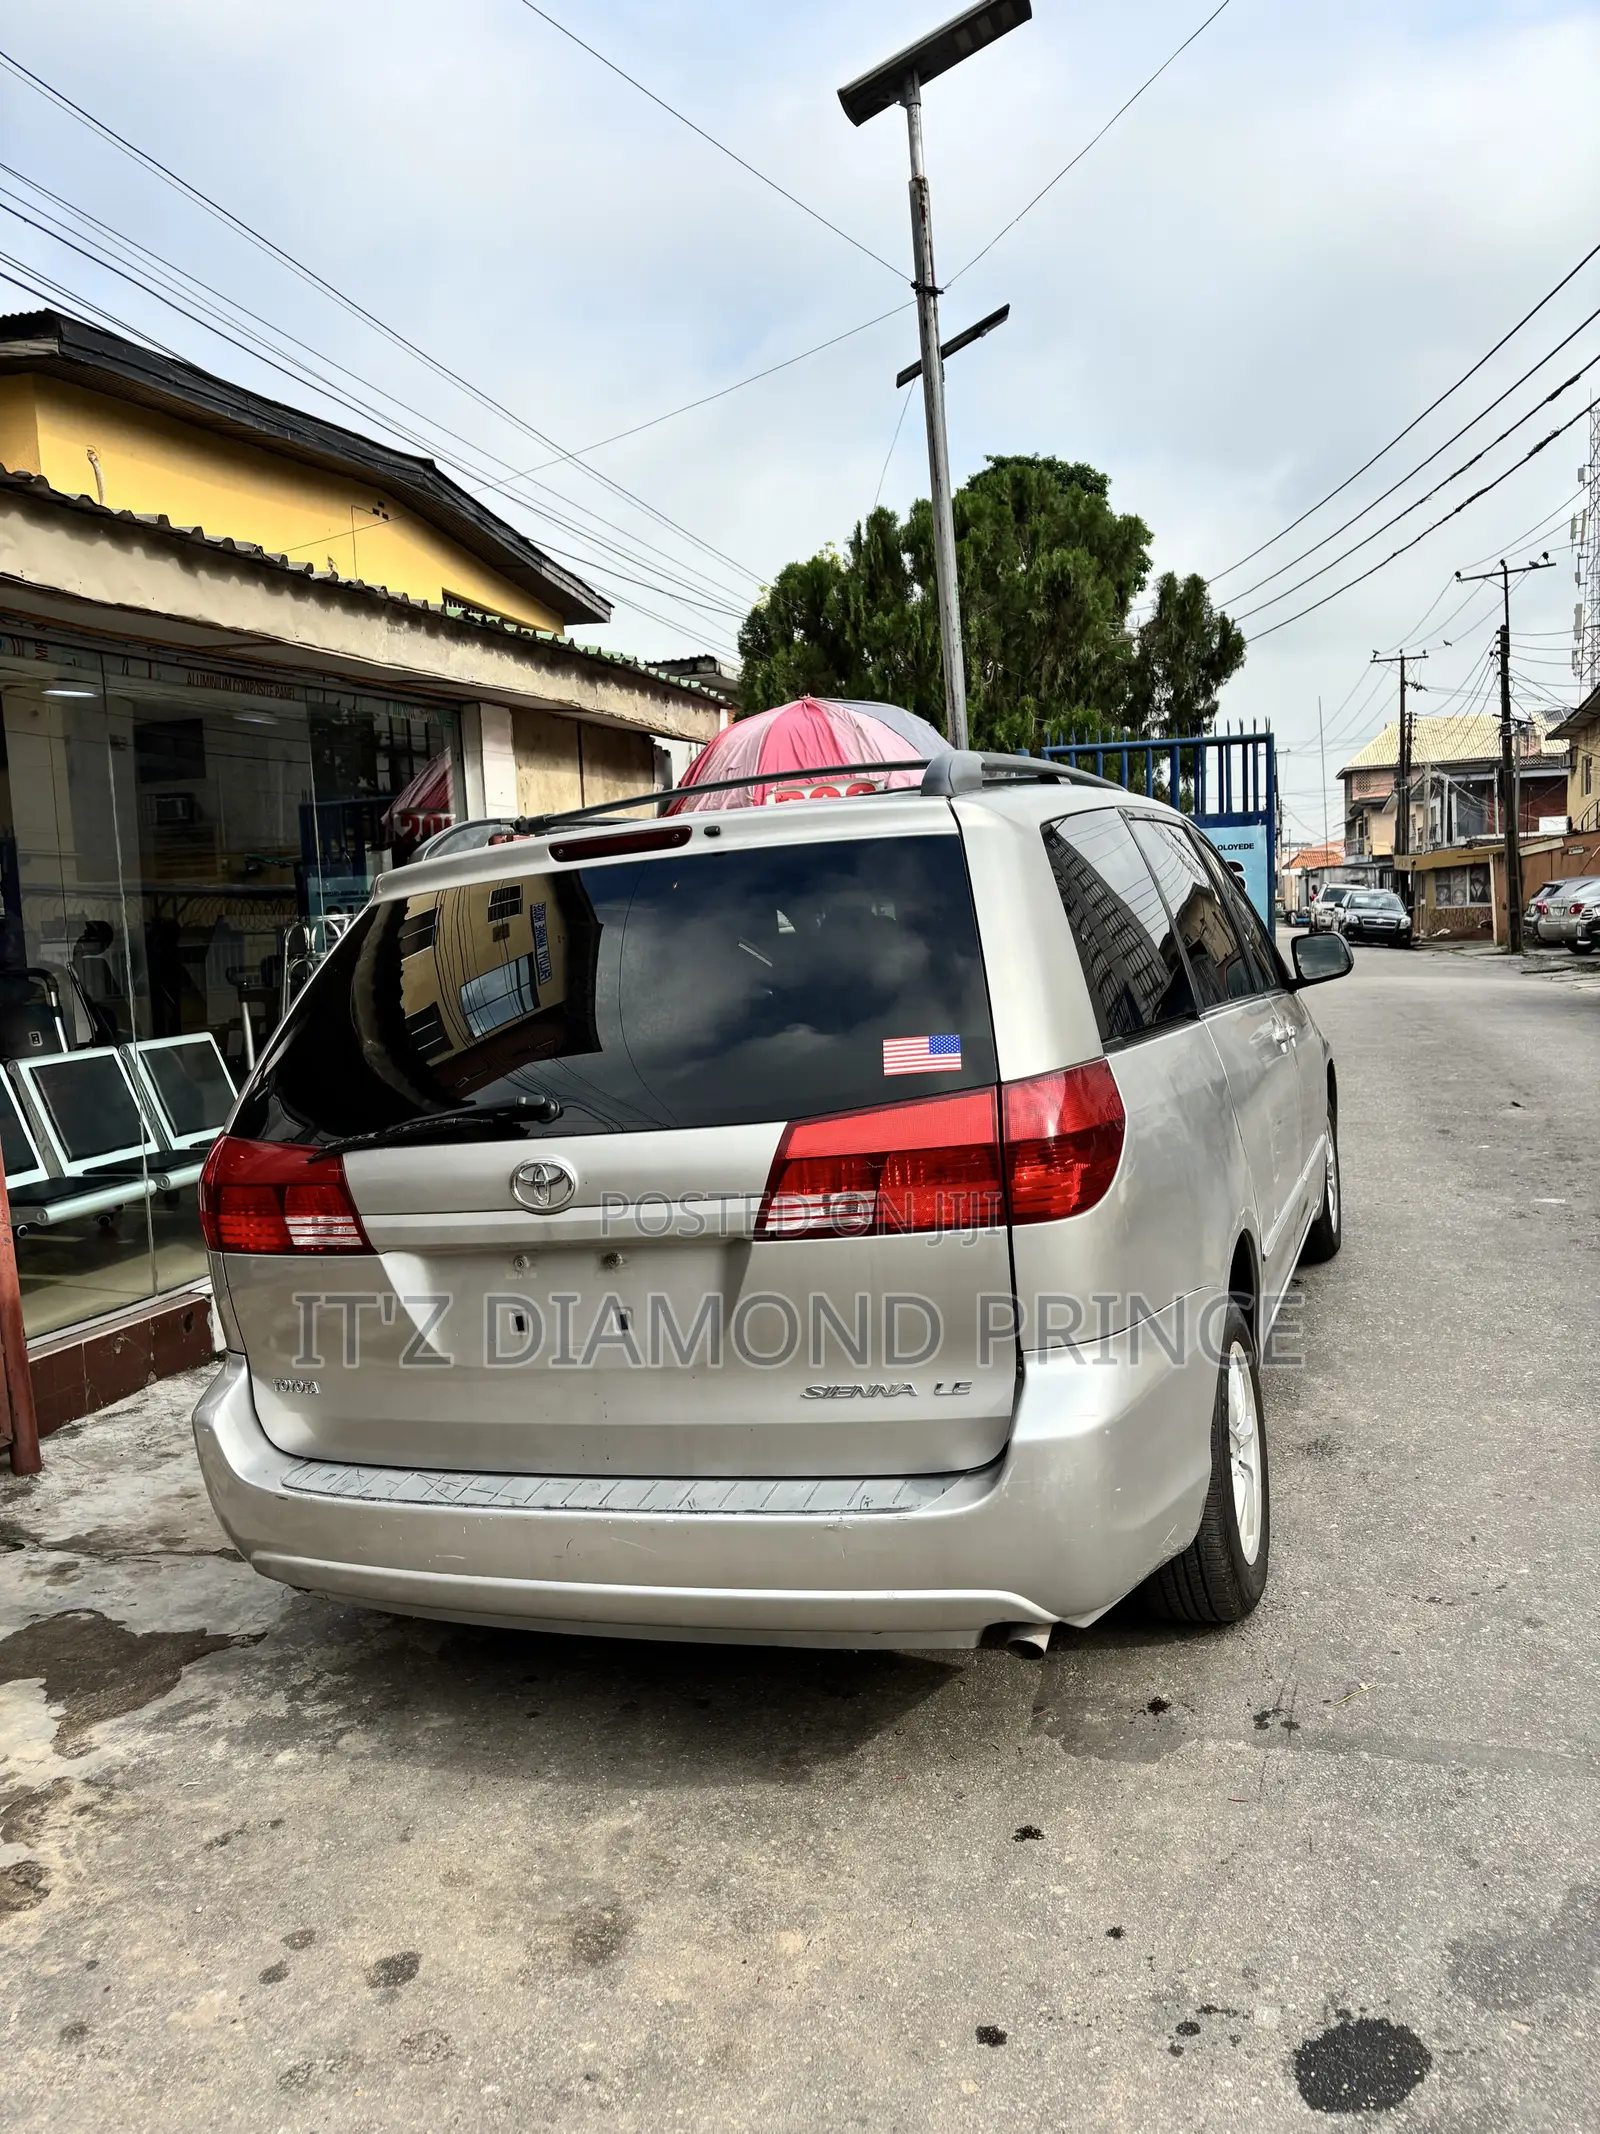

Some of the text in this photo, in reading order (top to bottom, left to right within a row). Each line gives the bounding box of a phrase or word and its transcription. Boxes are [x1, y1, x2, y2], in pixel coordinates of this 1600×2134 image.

[1217, 843, 1255, 851] OLOYEDE
[272, 1377, 321, 1394] TOYOTA
[800, 1379, 973, 1399] SIENNA LE
